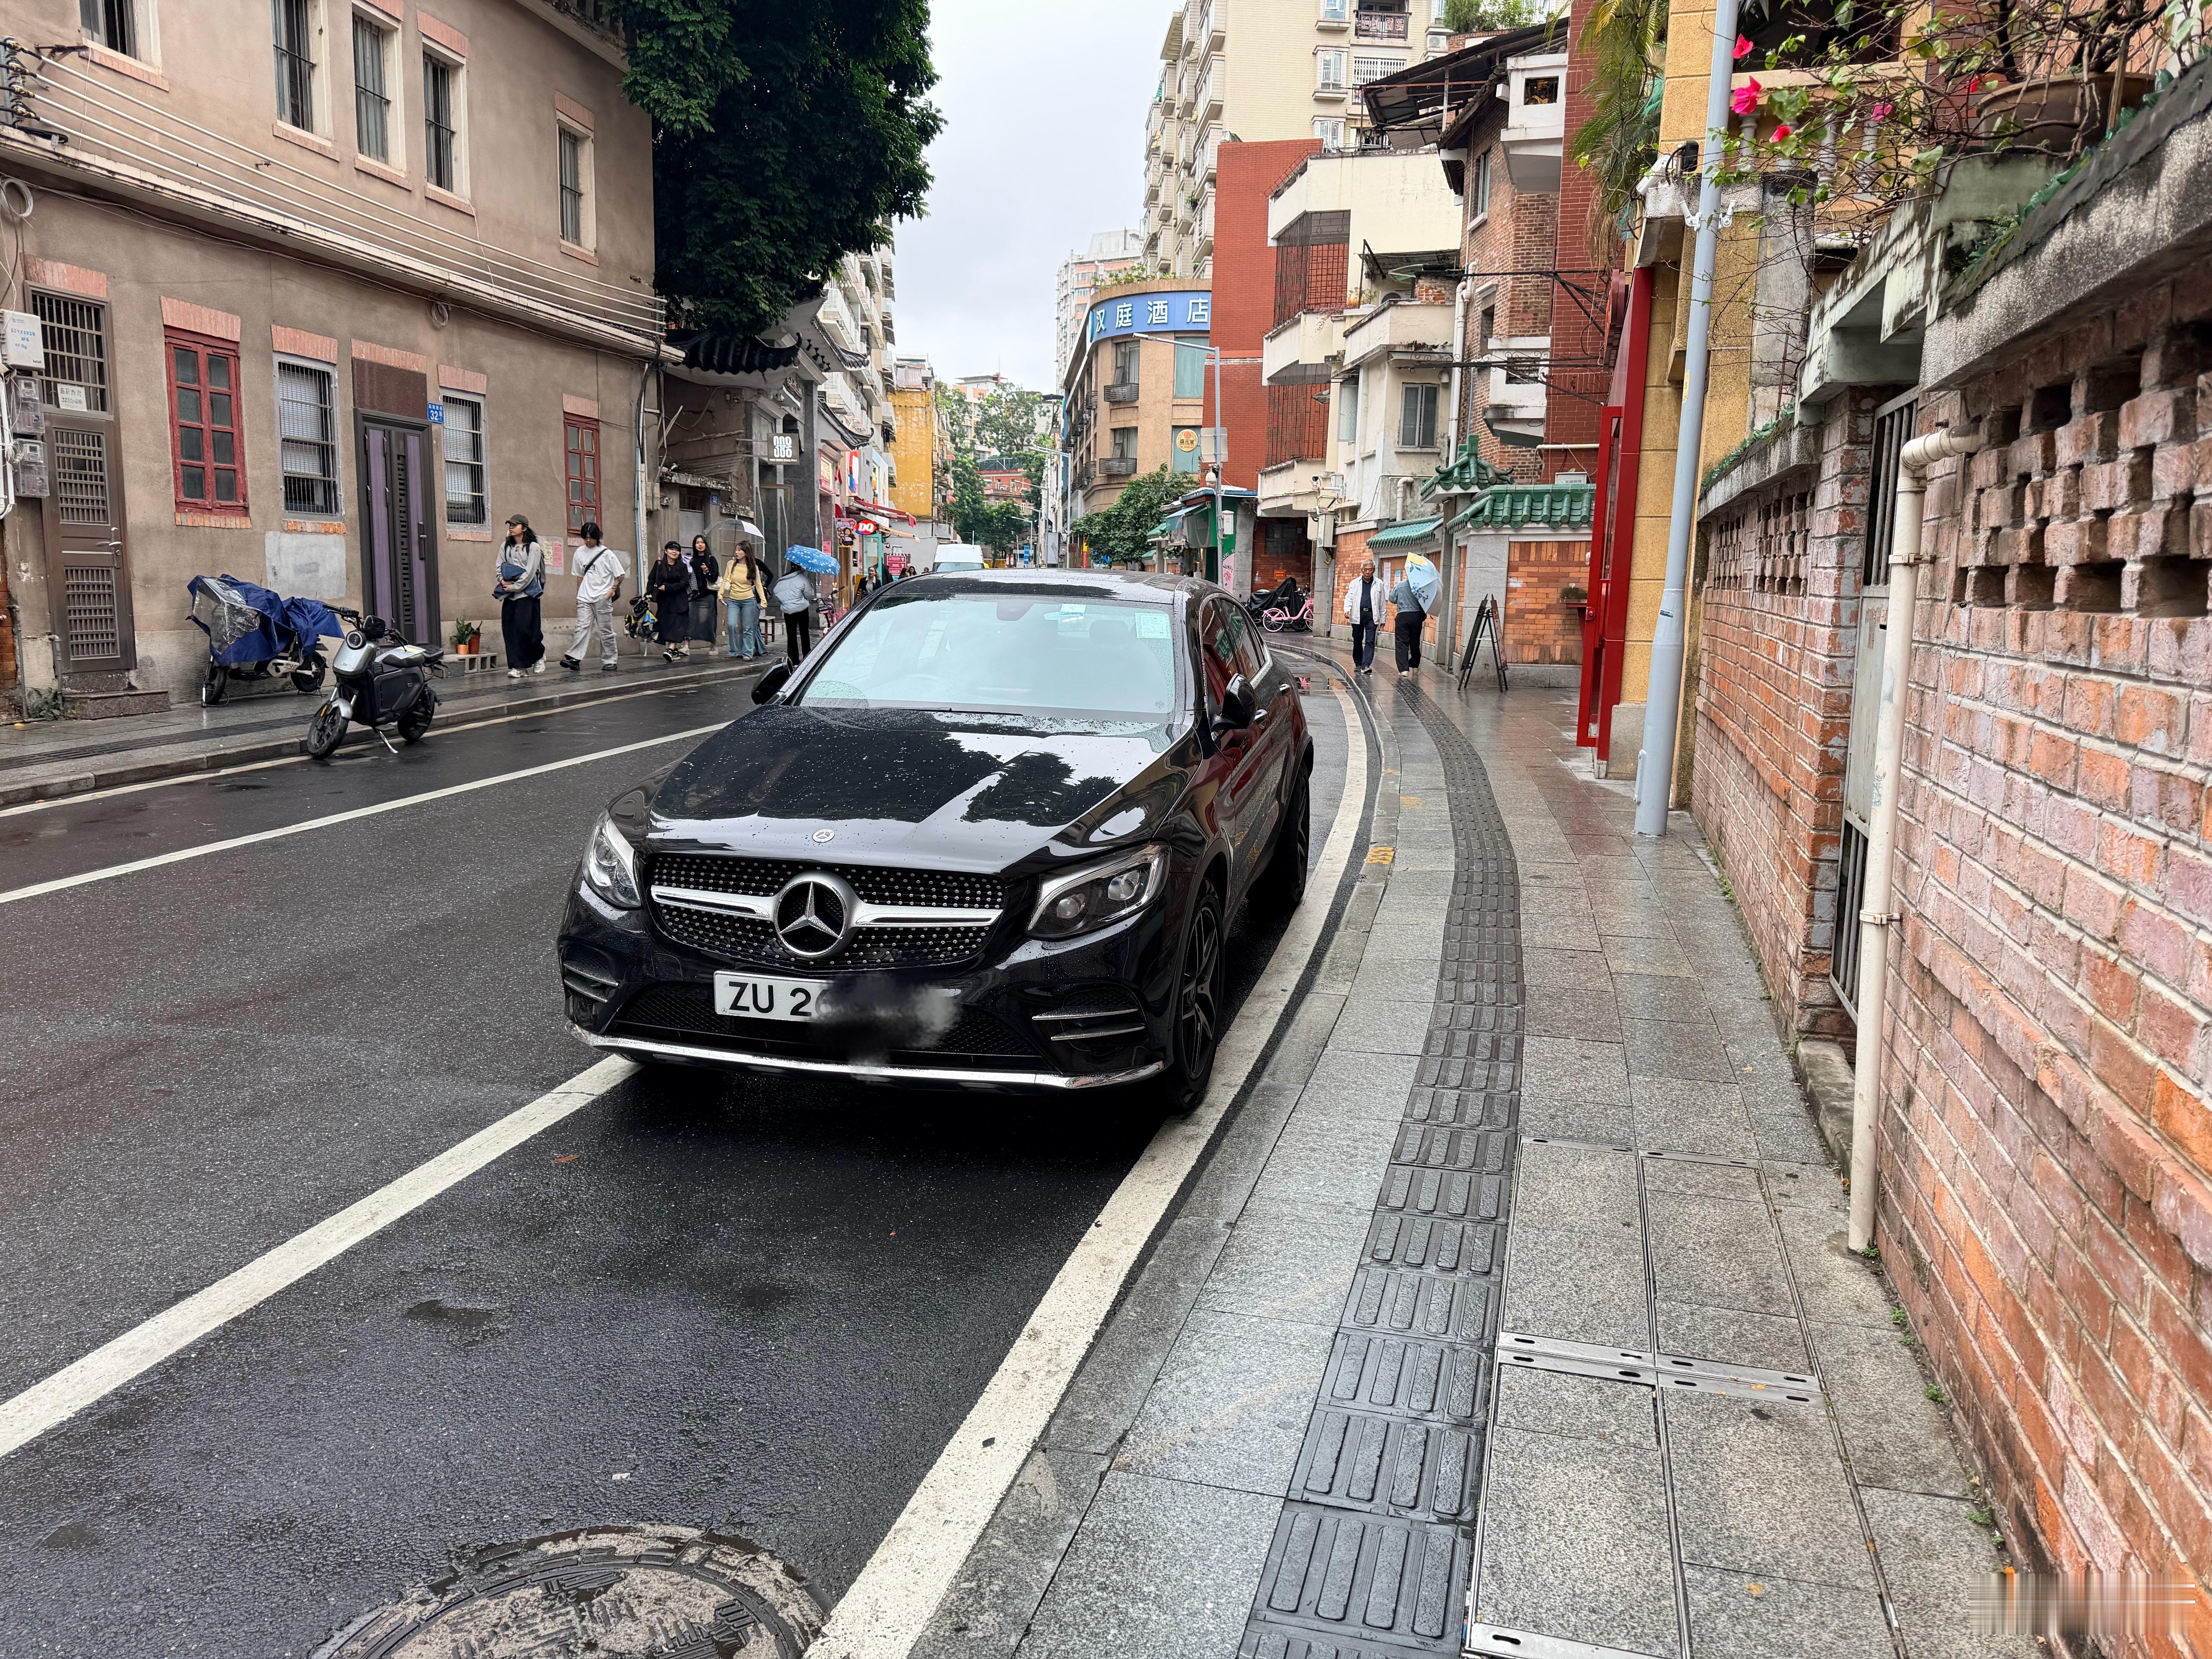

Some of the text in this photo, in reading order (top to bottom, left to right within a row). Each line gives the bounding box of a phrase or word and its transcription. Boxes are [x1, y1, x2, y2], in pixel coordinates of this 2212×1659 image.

[1096, 297, 1209, 332] 汉庭酒店
[859, 523, 874, 533] DQ
[728, 981, 774, 1013] ZU
